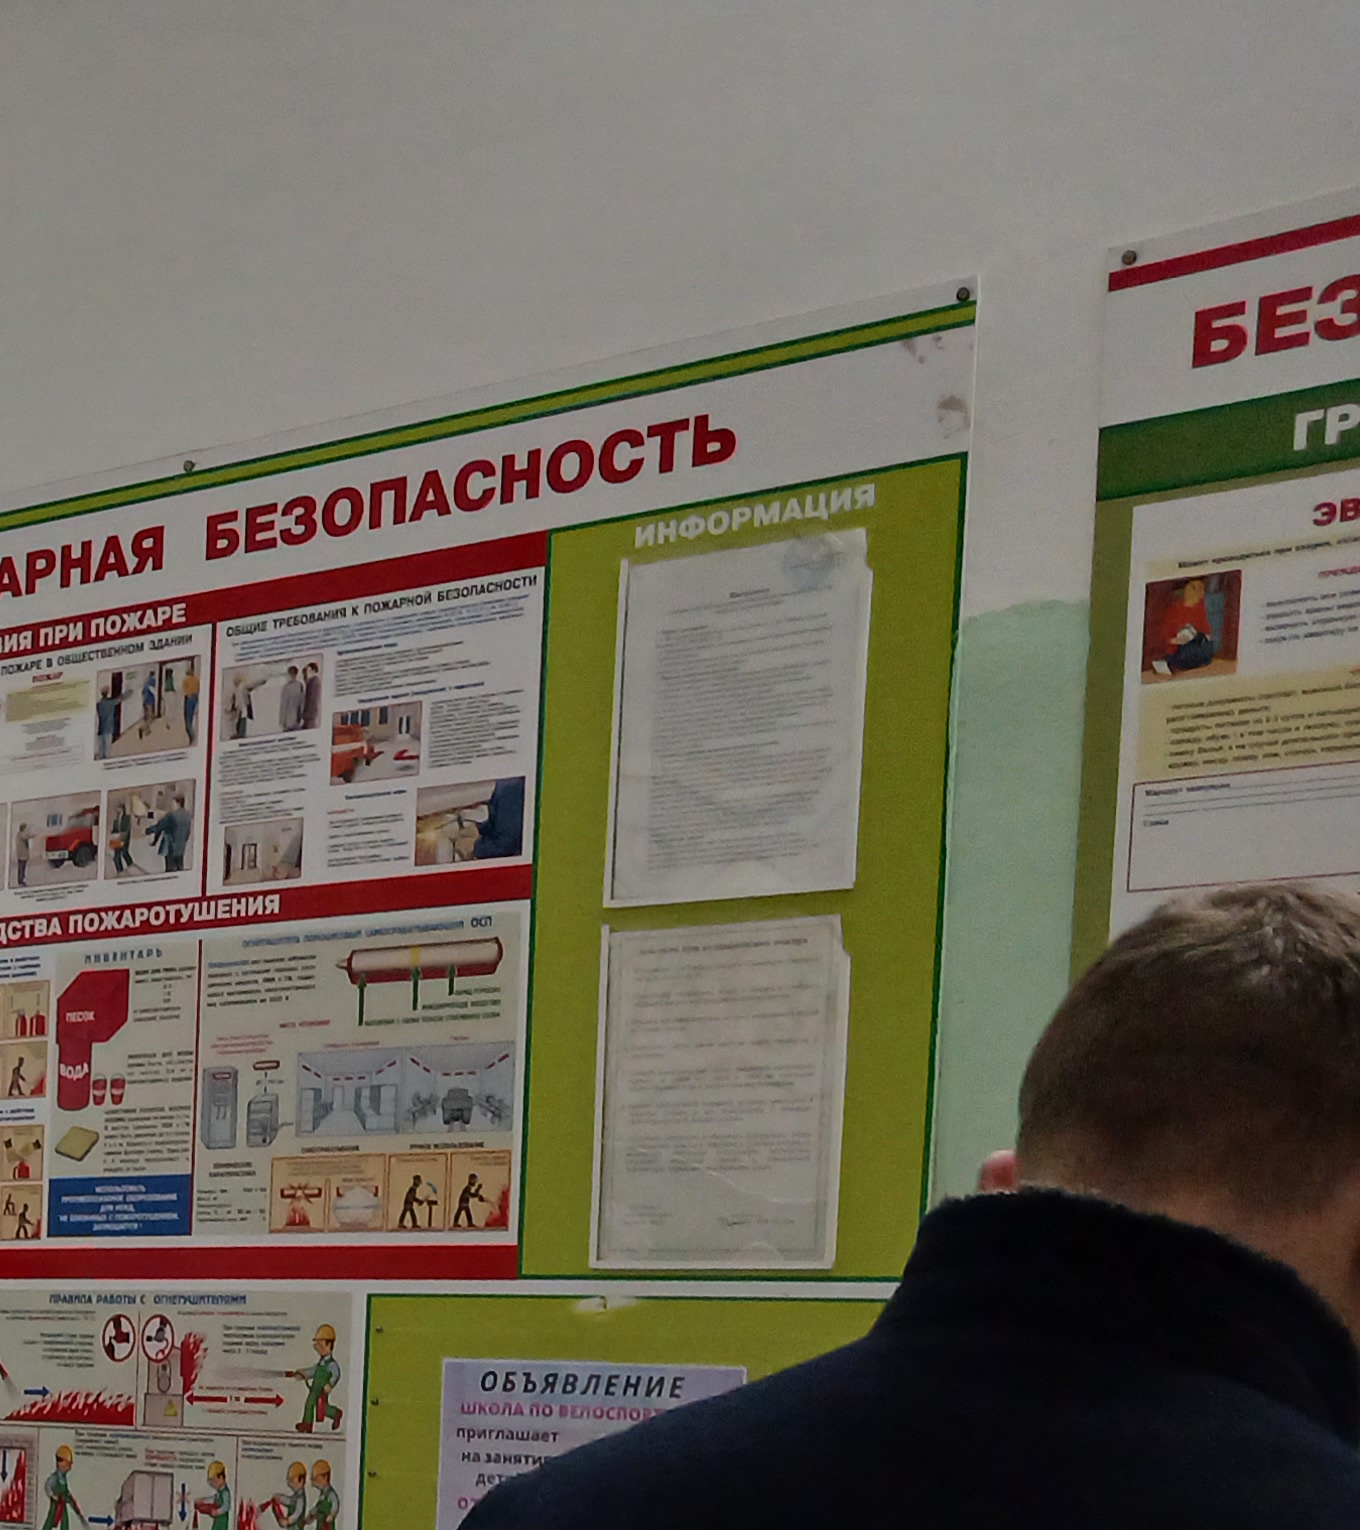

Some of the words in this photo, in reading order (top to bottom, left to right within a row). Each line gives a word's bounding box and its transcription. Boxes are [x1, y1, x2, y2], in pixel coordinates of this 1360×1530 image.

[1191, 273, 1360, 369] БЕЗ
[204, 414, 736, 560] БЕЗОПАСНОСТЬ
[634, 482, 876, 549] ИНФОРМАЦИЯ
[40, 620, 82, 647] ПРИ
[89, 603, 187, 637] ПОЖАРЕ
[226, 620, 267, 638] ОБЩИЕ
[273, 606, 347, 630] ТРЕБОВАНИЯ
[352, 605, 359, 617] К
[364, 592, 432, 614] ПОЖАРНОЙ
[437, 574, 537, 603] БЕЗОПАСНОСТИ
[1, 660, 42, 677] ПОЖАРЕ
[47, 657, 53, 668] В
[57, 642, 144, 666] ОБЩЕСТВЕННОМ
[149, 634, 193, 651] ЗДАНИИ
[68, 894, 280, 934] ПОЖАРОТУШЕНИЯ
[60, 1062, 89, 1081] ВОДА
[49, 1294, 93, 1304] ПРАВИЛА
[96, 1294, 136, 1305] РАБОТЫ
[480, 1370, 686, 1400] ОБЪЯВЛЕНИЕ
[460, 1402, 525, 1418] ШКОЛА
[530, 1403, 554, 1418] ПО
[456, 1426, 560, 1445] приглашает
[462, 1451, 481, 1463] на
